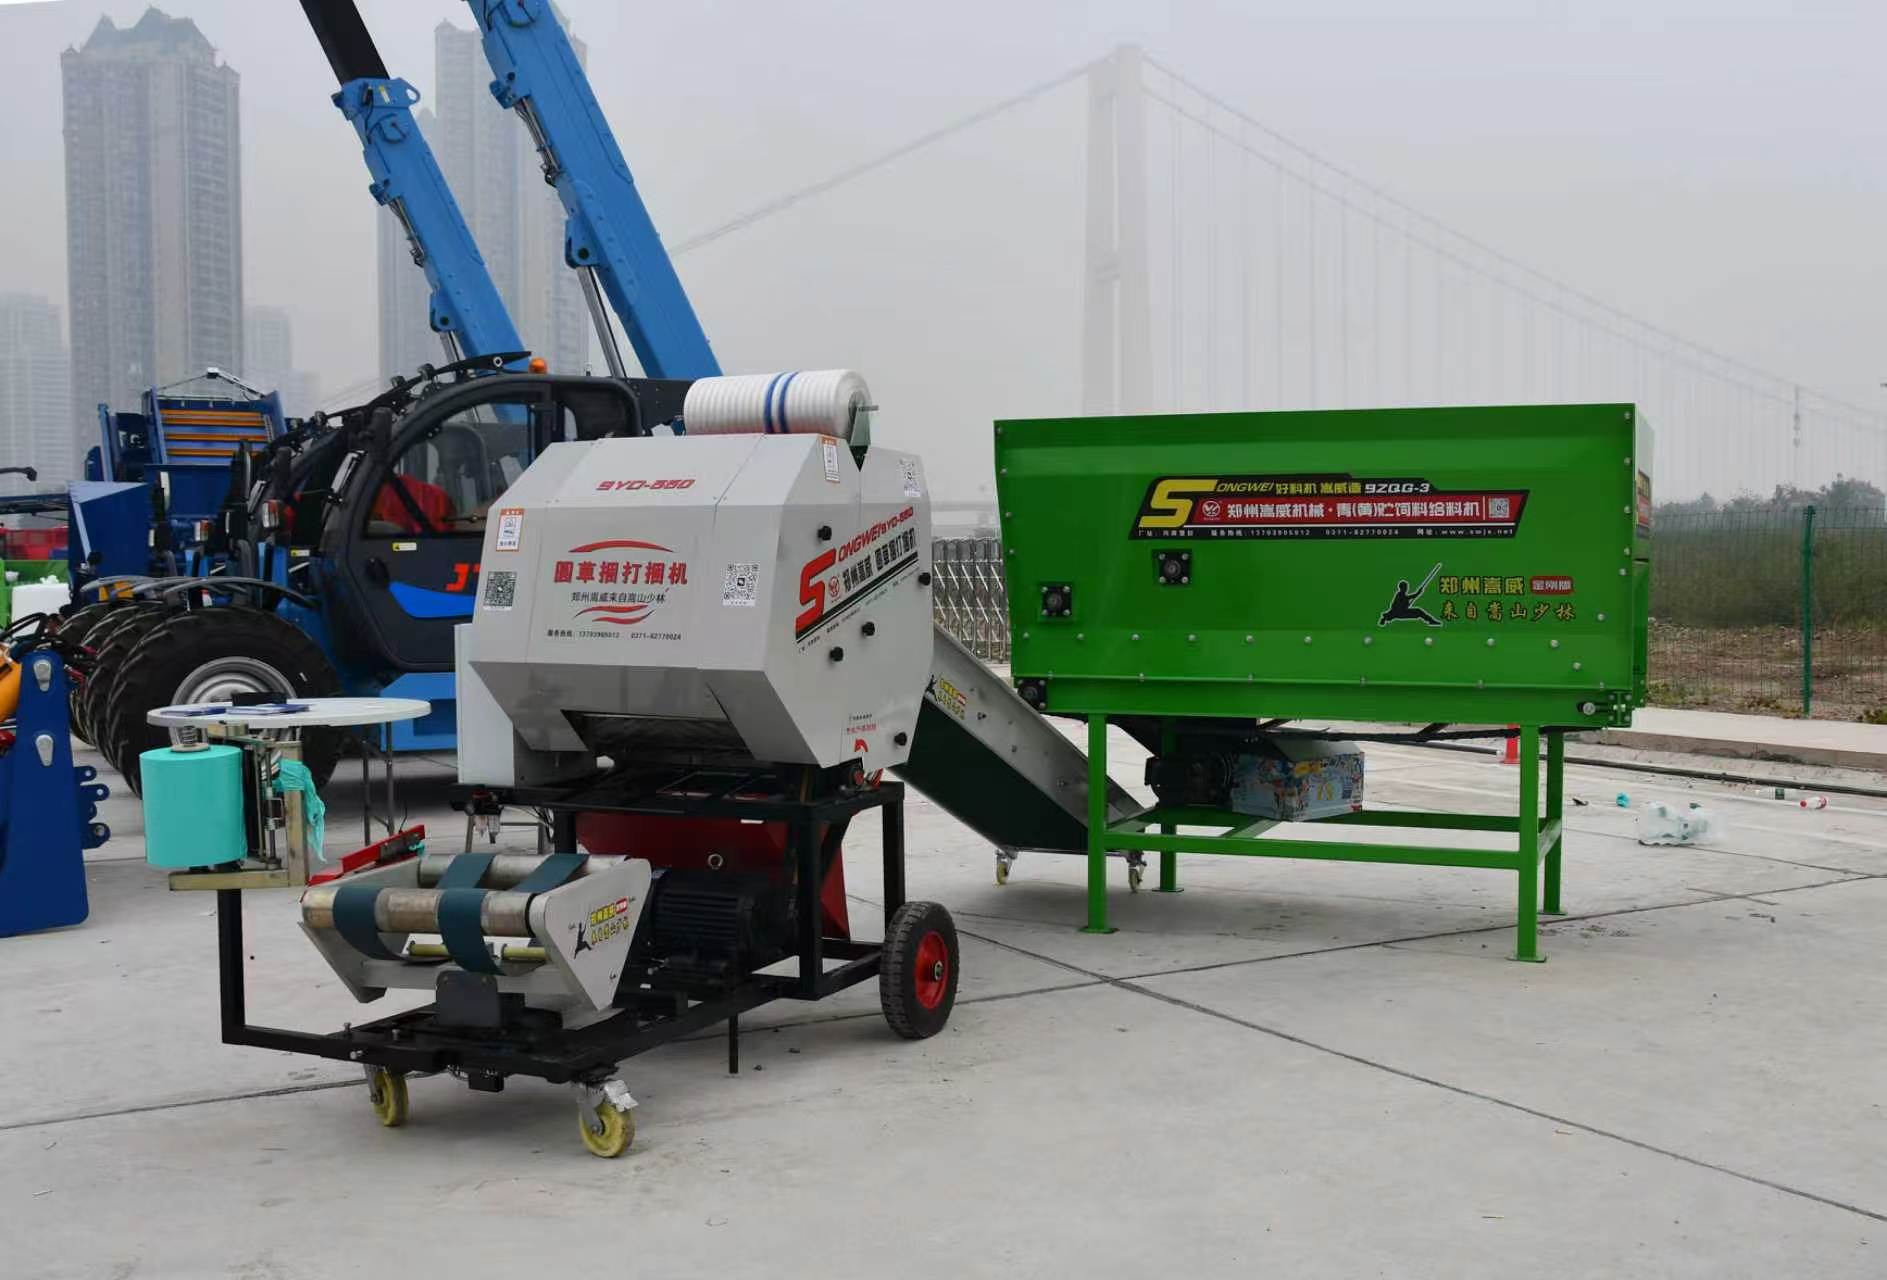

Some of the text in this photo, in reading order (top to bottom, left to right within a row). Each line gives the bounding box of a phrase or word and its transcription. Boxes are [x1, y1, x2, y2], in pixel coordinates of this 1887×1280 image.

[1364, 482, 1430, 494] 9ZQG-3
[1439, 577, 1524, 595] 郑州嵩威
[1442, 602, 1576, 621] 来自嵩山少林
